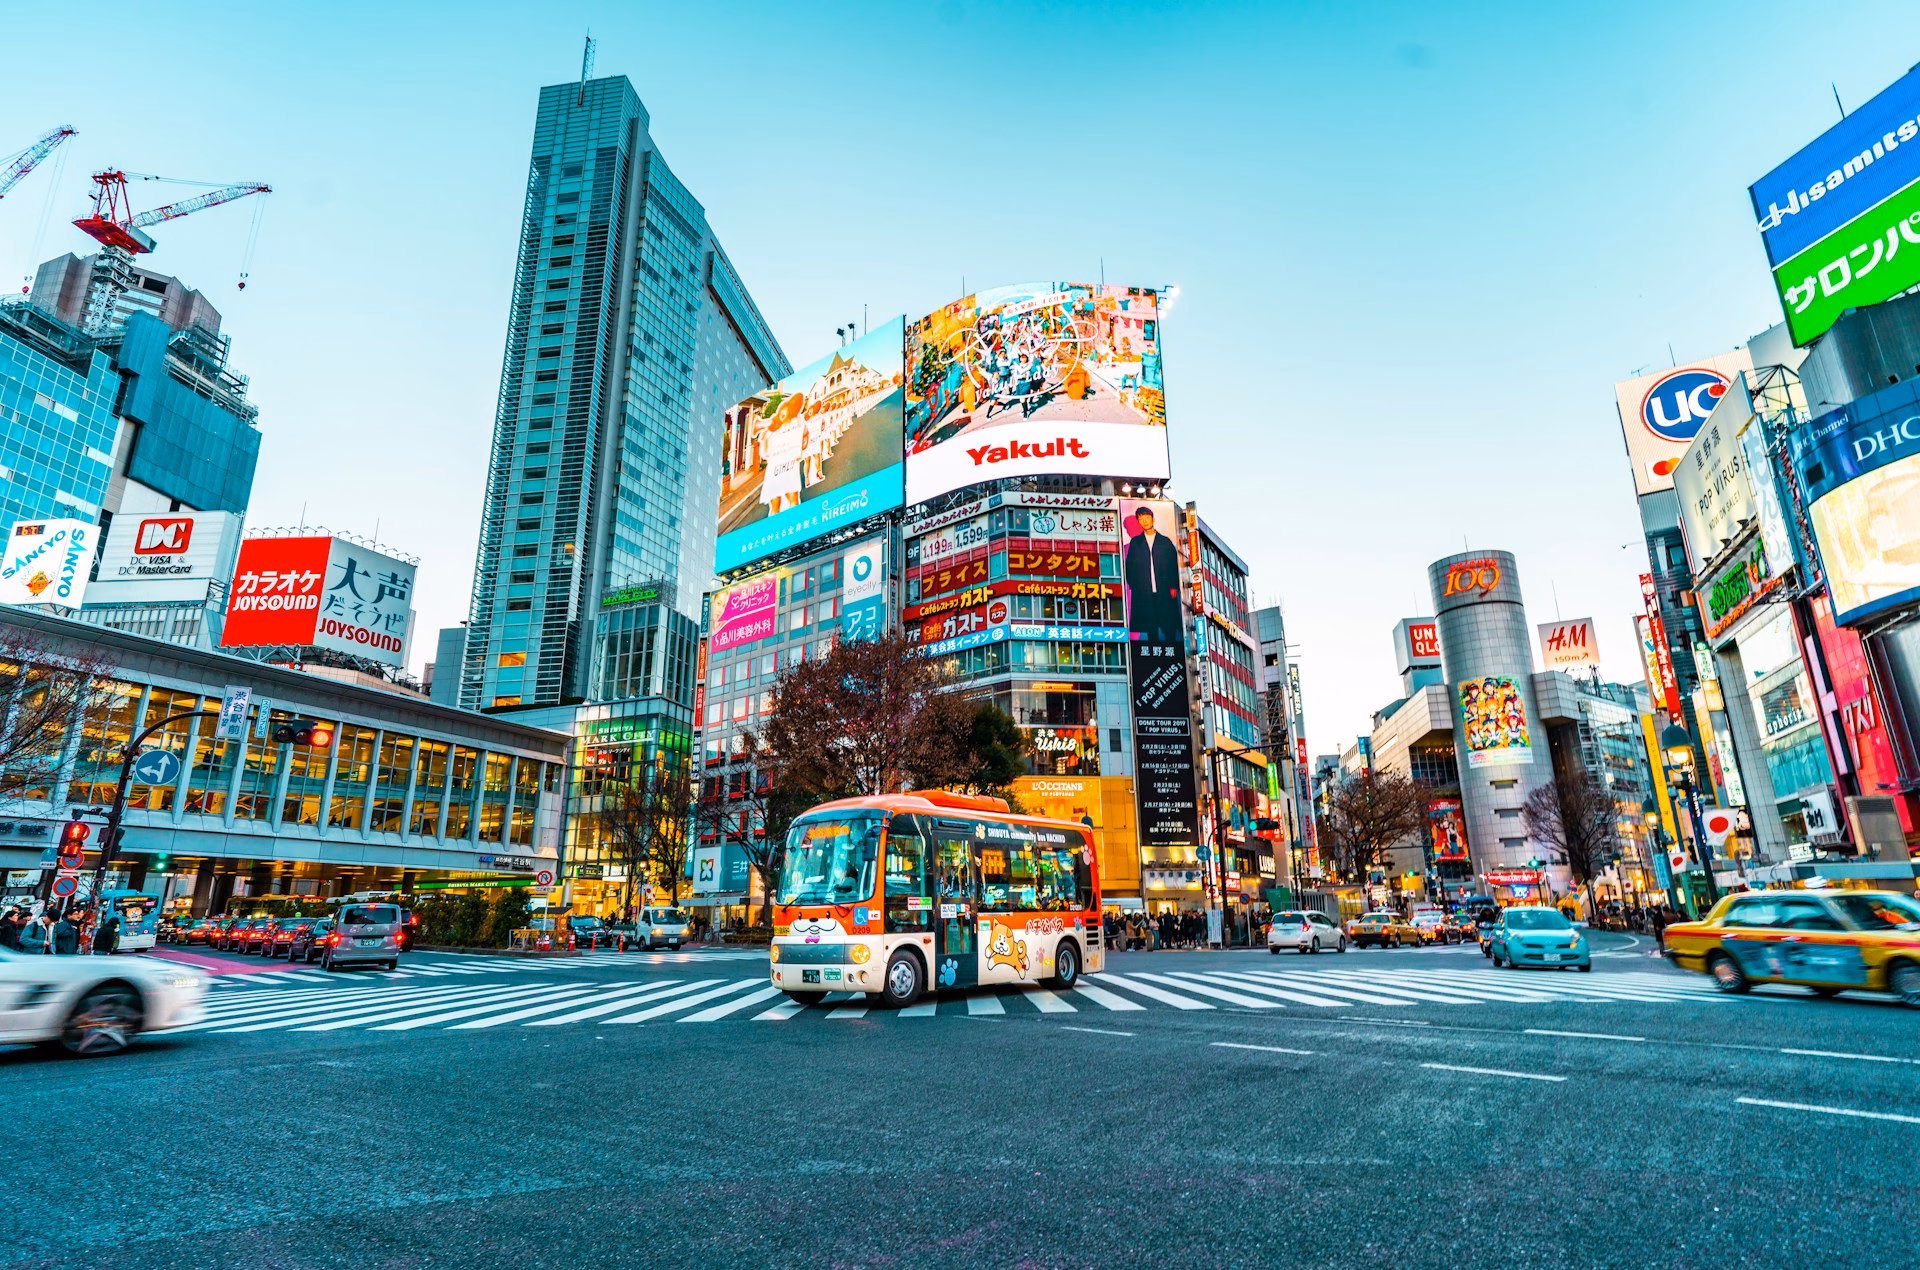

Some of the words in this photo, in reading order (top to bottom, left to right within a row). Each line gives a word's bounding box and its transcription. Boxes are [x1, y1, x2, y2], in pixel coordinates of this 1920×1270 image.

[1756, 115, 1920, 233] Hisamits
[1811, 412, 1850, 441] Channel
[966, 437, 1090, 466] Yakult
[1060, 514, 1115, 532] しゃぶ葉
[139, 522, 187, 550] DC
[1, 529, 66, 579] SANKYO
[56, 527, 88, 598] SANKYO
[130, 556, 147, 565] DC
[149, 555, 171, 564] VISA
[907, 545, 920, 559] 9F
[1008, 553, 1097, 572] コンタクト
[118, 566, 135, 575] DC
[136, 564, 193, 575] MasterCard
[327, 556, 411, 604] 大声
[923, 556, 988, 593] プライス
[236, 569, 321, 594] カラオケ
[741, 580, 774, 602] 品川スキン
[847, 580, 877, 597] eyecity
[1071, 582, 1114, 600] ガスト
[1442, 565, 1501, 599] 109
[232, 594, 319, 612] JOYSOUND
[739, 592, 769, 611] クリニック
[960, 586, 994, 609] ガスト
[318, 617, 403, 653] JOYSOUND
[719, 617, 772, 646] 品川美容外科
[943, 611, 984, 639] ガスト
[993, 629, 1003, 640] 6F
[1047, 627, 1126, 640] 英会話イーオン
[929, 632, 990, 656] 英会話イーオン
[1546, 623, 1588, 651] H&M
[1140, 646, 1175, 657] 星野源
[223, 696, 234, 717] Shibuya
[1152, 695, 1165, 709] NOW
[1163, 688, 1172, 698] ON
[228, 690, 247, 735] 渋谷駅前
[1034, 736, 1077, 752] Ushi8
[733, 860, 748, 873] 三井
[852, 926, 871, 934] D209
[1025, 916, 1065, 936] ハチ公バス
